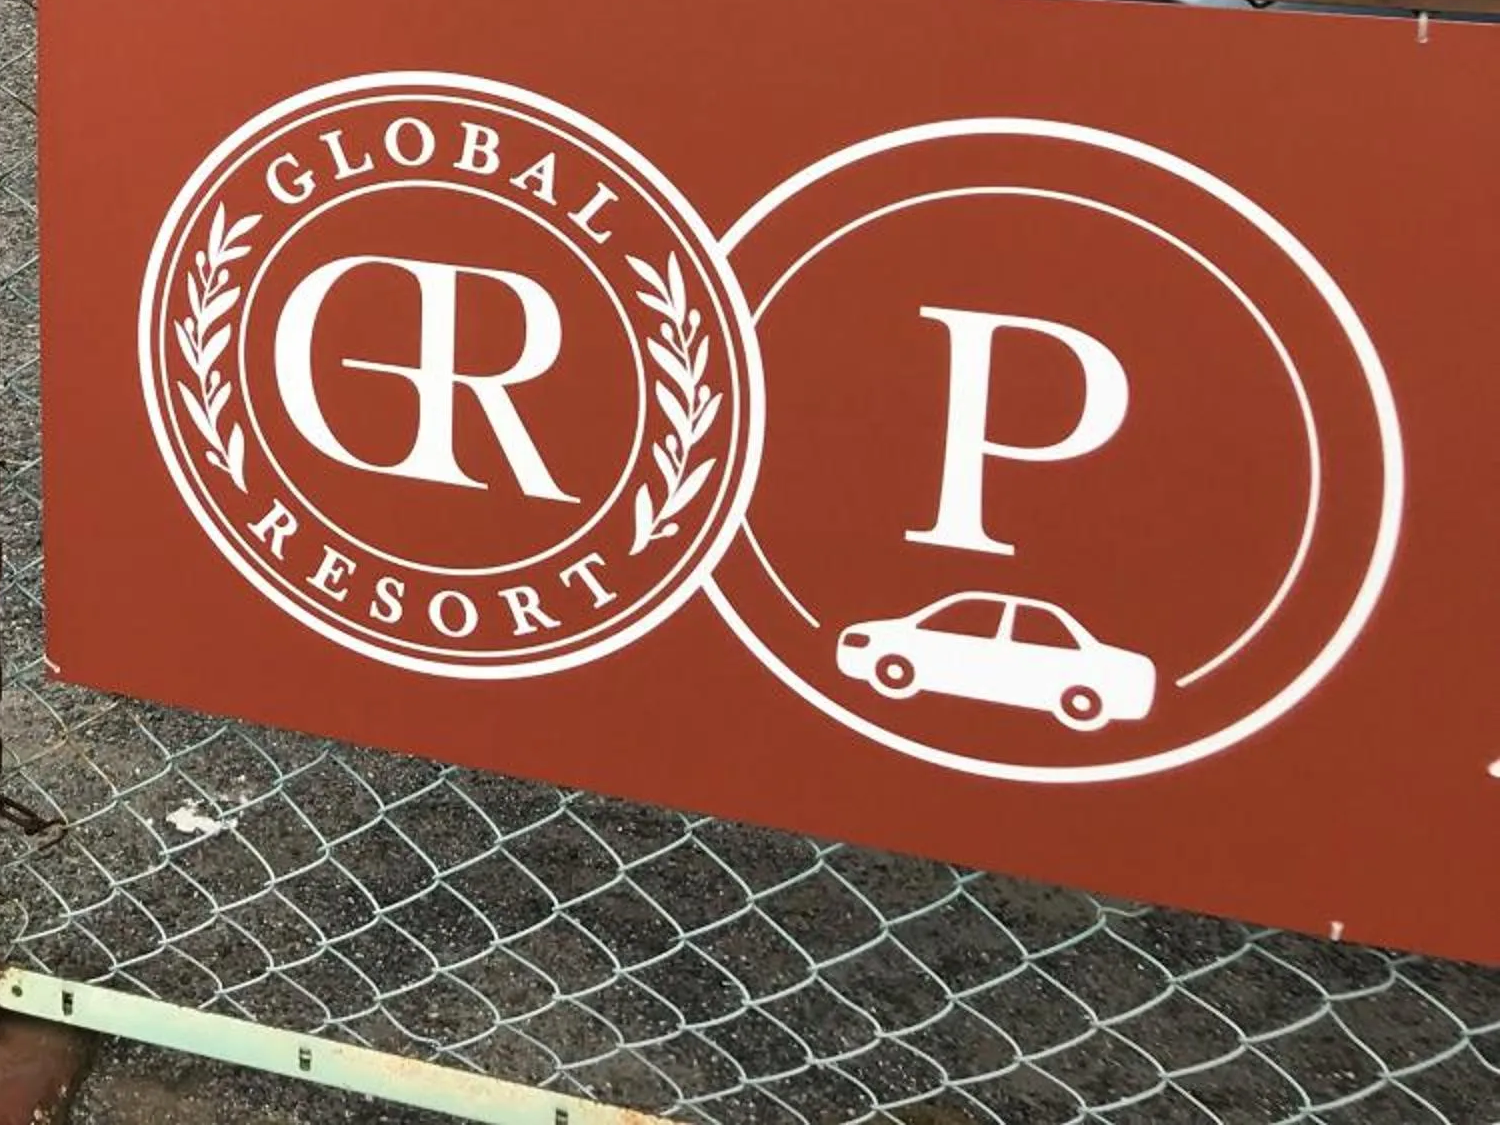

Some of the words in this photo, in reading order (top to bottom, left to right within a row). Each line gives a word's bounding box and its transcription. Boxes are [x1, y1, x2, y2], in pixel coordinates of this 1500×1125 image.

[267, 118, 618, 243] GLOBAL
[906, 307, 1128, 555] P
[248, 499, 616, 637] RESORT
